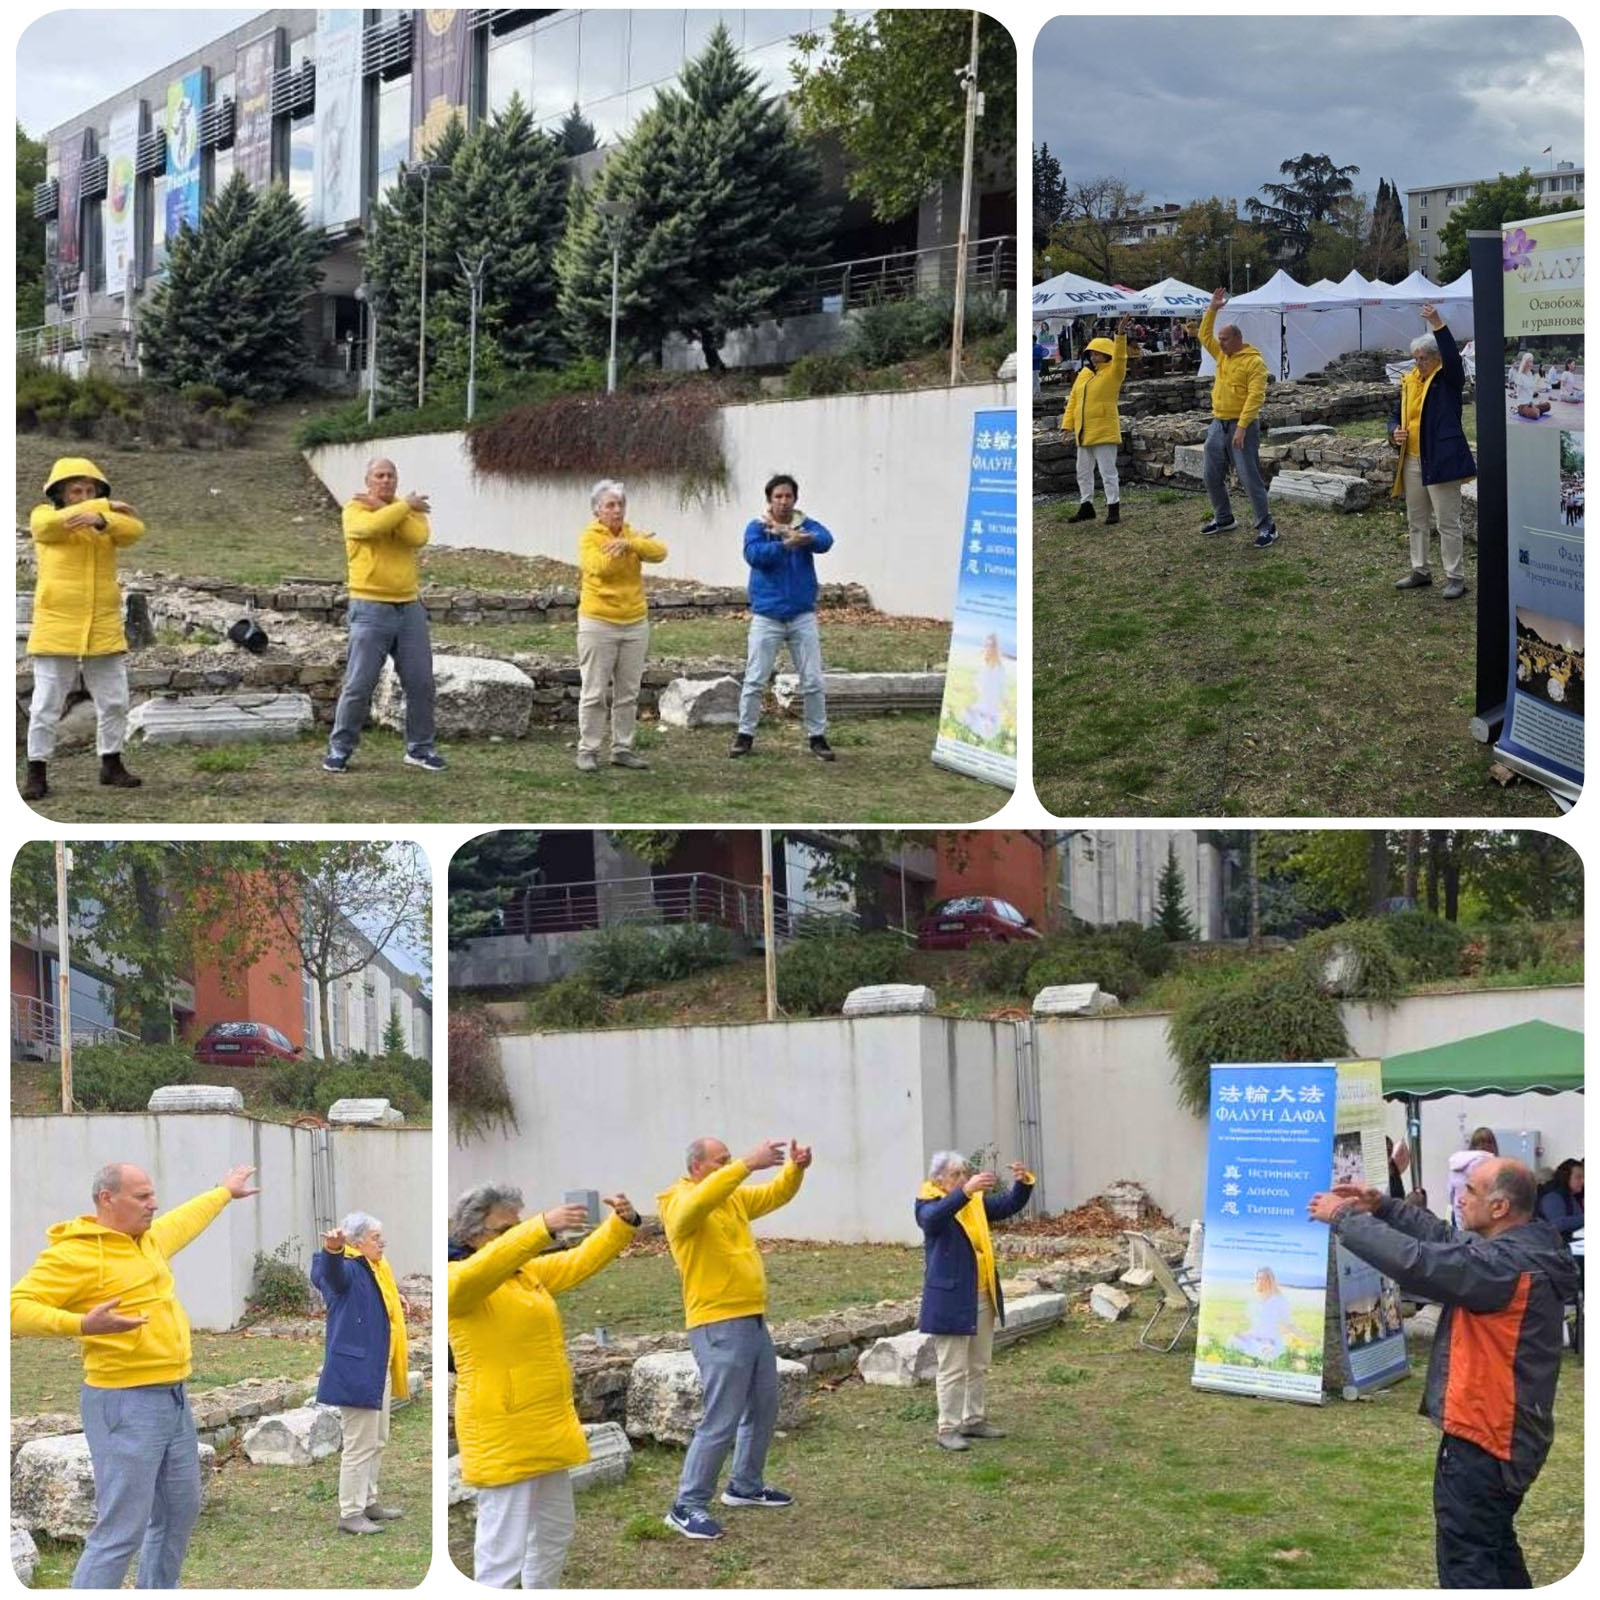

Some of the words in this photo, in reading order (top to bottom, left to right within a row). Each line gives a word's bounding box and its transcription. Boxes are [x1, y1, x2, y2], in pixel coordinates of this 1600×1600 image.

[1517, 256, 1584, 283] ФАЛУ
[1065, 289, 1125, 302] DEVIN
[1522, 319, 1529, 328] и
[972, 455, 1012, 471] ФАЛУН
[1218, 1085, 1325, 1103] 法輪大法
[1216, 1106, 1274, 1121] ФАЛУН
[1278, 1108, 1327, 1122] ДАФА
